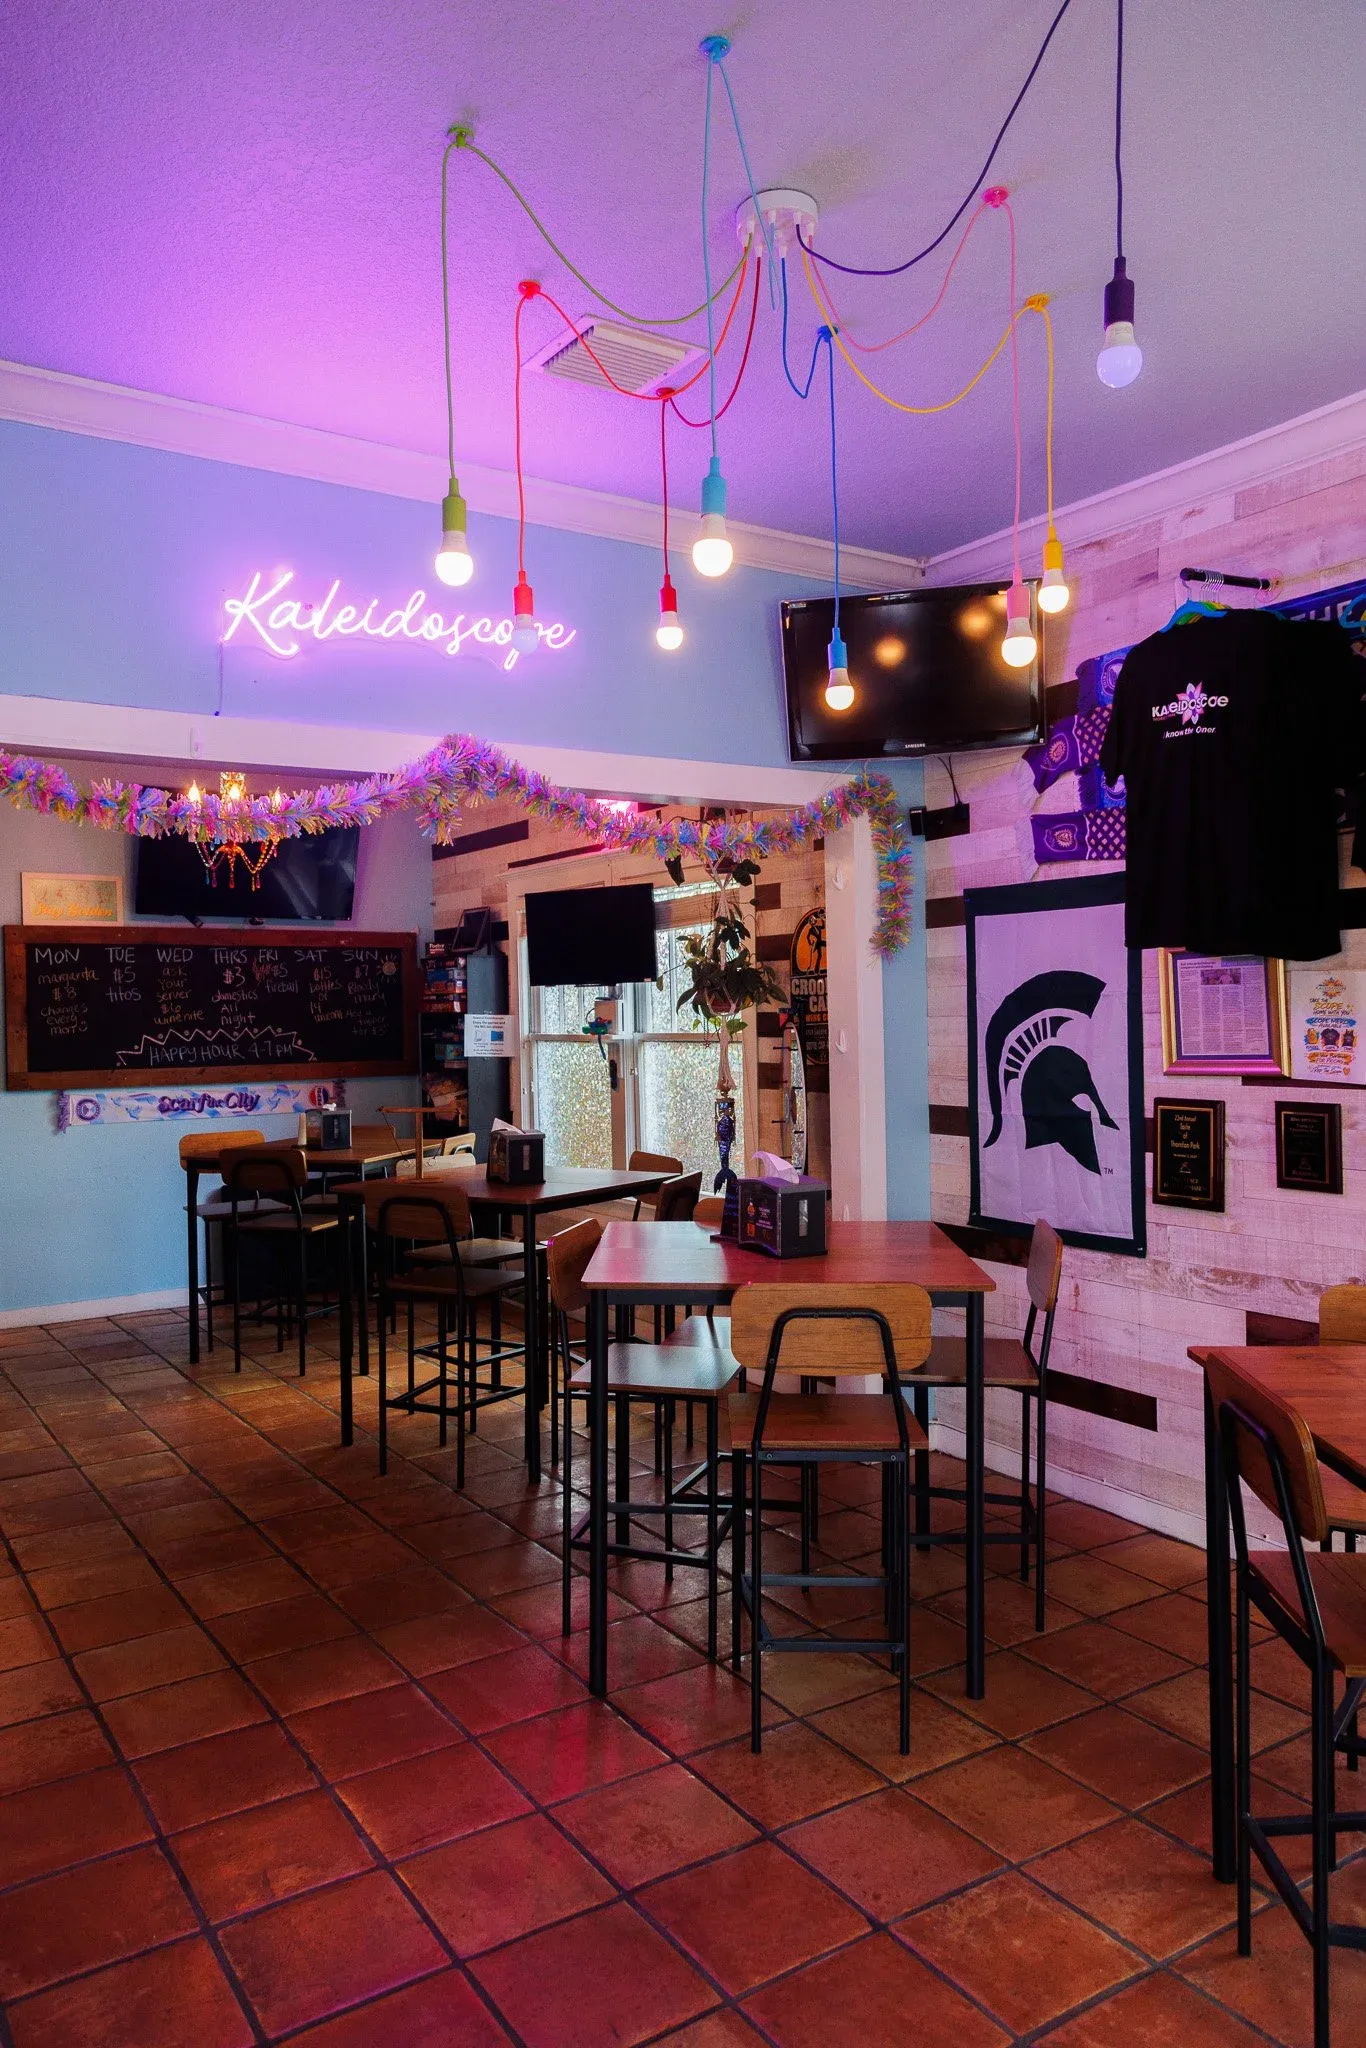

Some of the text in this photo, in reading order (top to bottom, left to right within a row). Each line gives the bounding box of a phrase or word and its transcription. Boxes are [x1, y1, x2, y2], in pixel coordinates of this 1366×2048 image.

[224, 571, 577, 671] Kaleidoscope
[1151, 693, 1229, 718] KAeIDOSCOe
[35, 947, 379, 966] MON TUE WED THRS FRI SAT SUN
[114, 966, 136, 983] $5
[223, 966, 246, 987] $3
[105, 987, 141, 1002] titos
[211, 990, 258, 1002] domestics
[791, 978, 828, 996] CROO
[809, 996, 829, 1013] CA
[1314, 1002, 1343, 1010] SCOPE
[221, 1011, 256, 1029] night
[150, 1045, 197, 1067] HAPPY
[201, 1041, 245, 1061] HOUR
[277, 1042, 293, 1057] PM
[1190, 1141, 1200, 1150] Park
